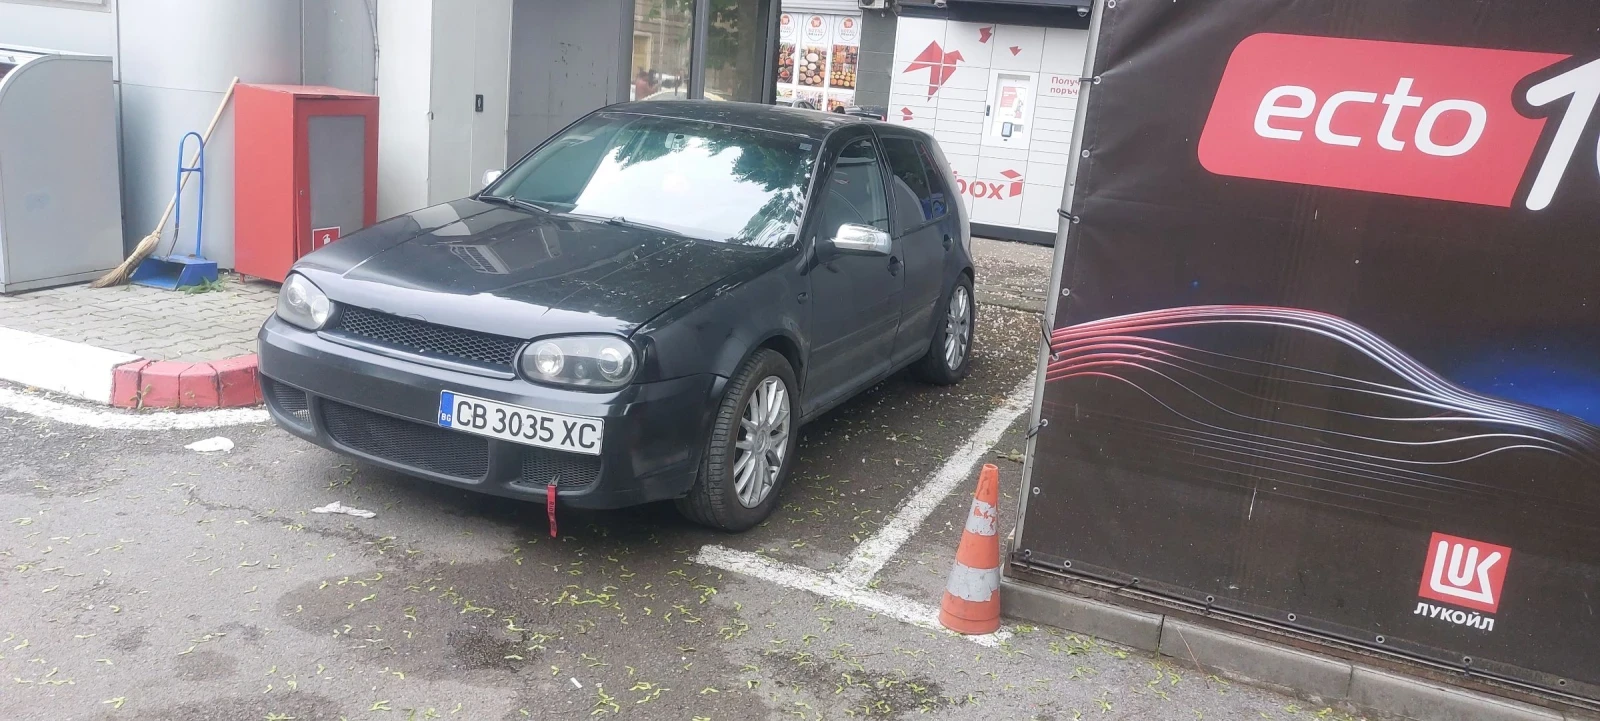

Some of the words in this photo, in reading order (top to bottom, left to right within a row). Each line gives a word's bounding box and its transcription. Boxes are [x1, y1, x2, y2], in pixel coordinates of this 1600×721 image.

[1253, 77, 1487, 157] ecto
[1526, 58, 1600, 211] 1
[441, 412, 452, 422] BG
[456, 400, 488, 430] CB
[492, 408, 554, 443] 3035
[560, 419, 597, 449] XC
[1413, 602, 1495, 632] ЛУКОЙЛ
